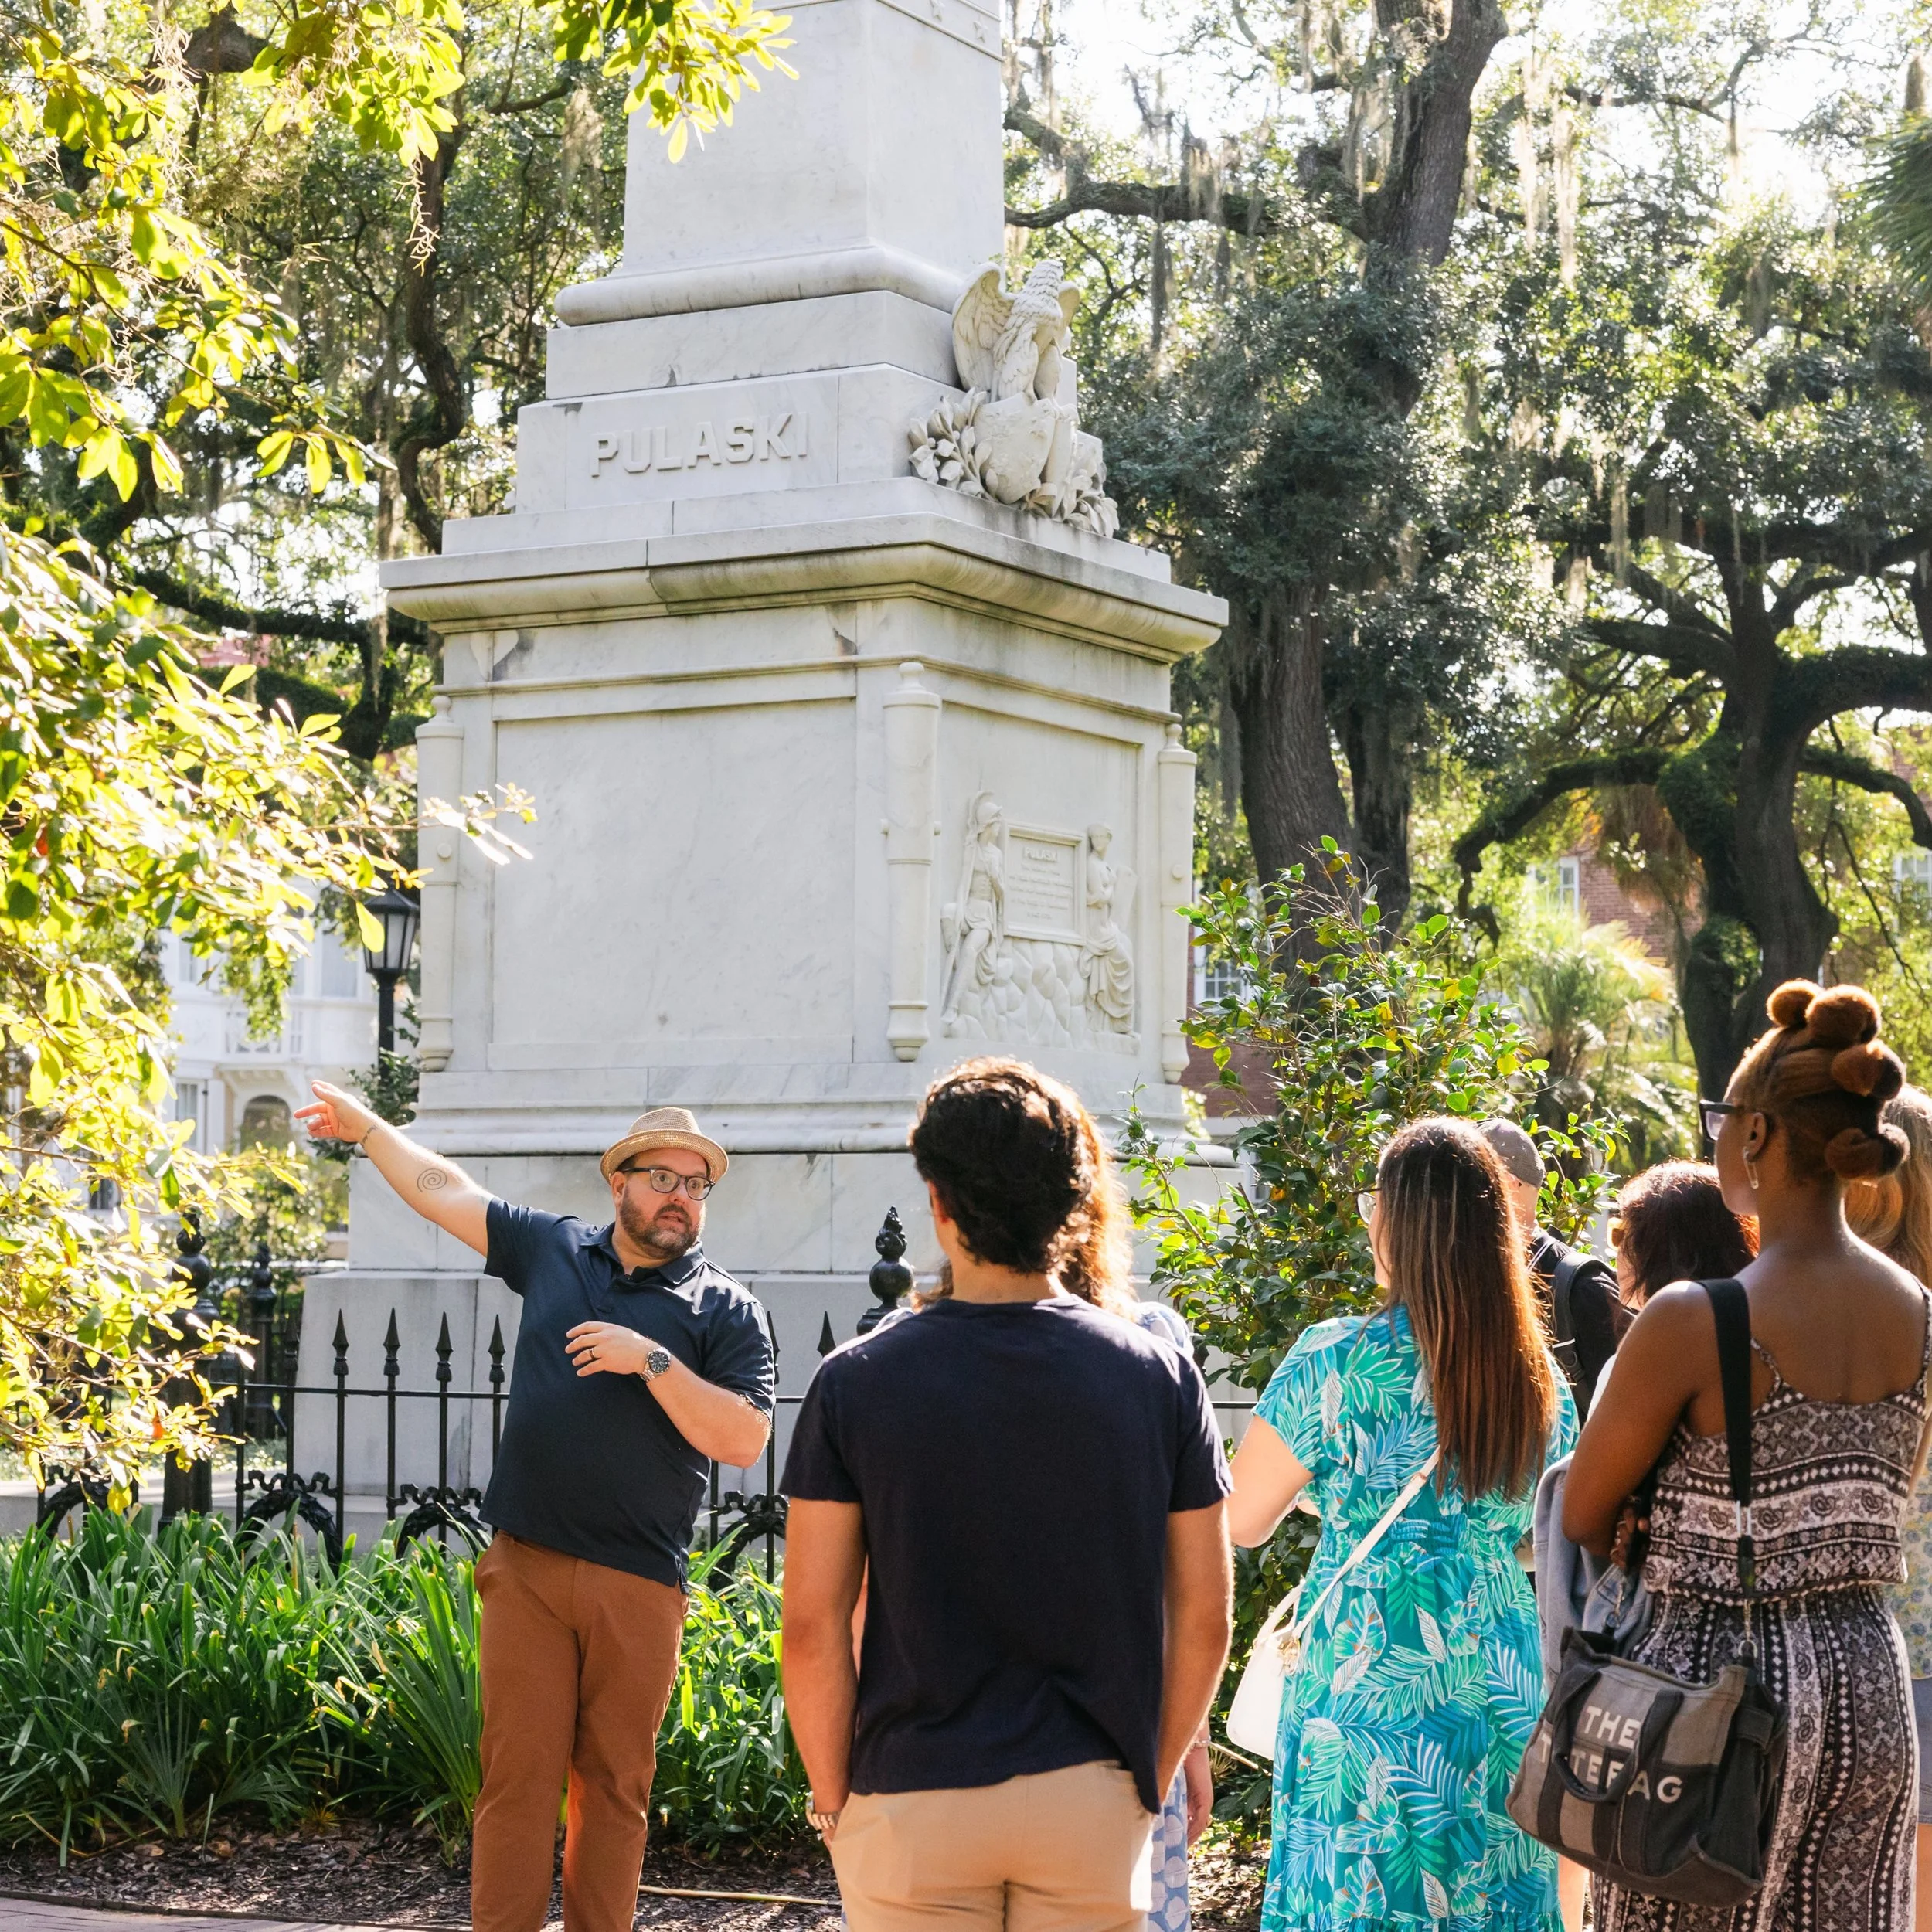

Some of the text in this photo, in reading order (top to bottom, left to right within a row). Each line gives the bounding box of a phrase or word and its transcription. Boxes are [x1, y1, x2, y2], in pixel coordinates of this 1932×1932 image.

[589, 411, 811, 478] PULASKI
[1584, 1706, 1641, 1750] THE
[1541, 1733, 1603, 1786] TTE
